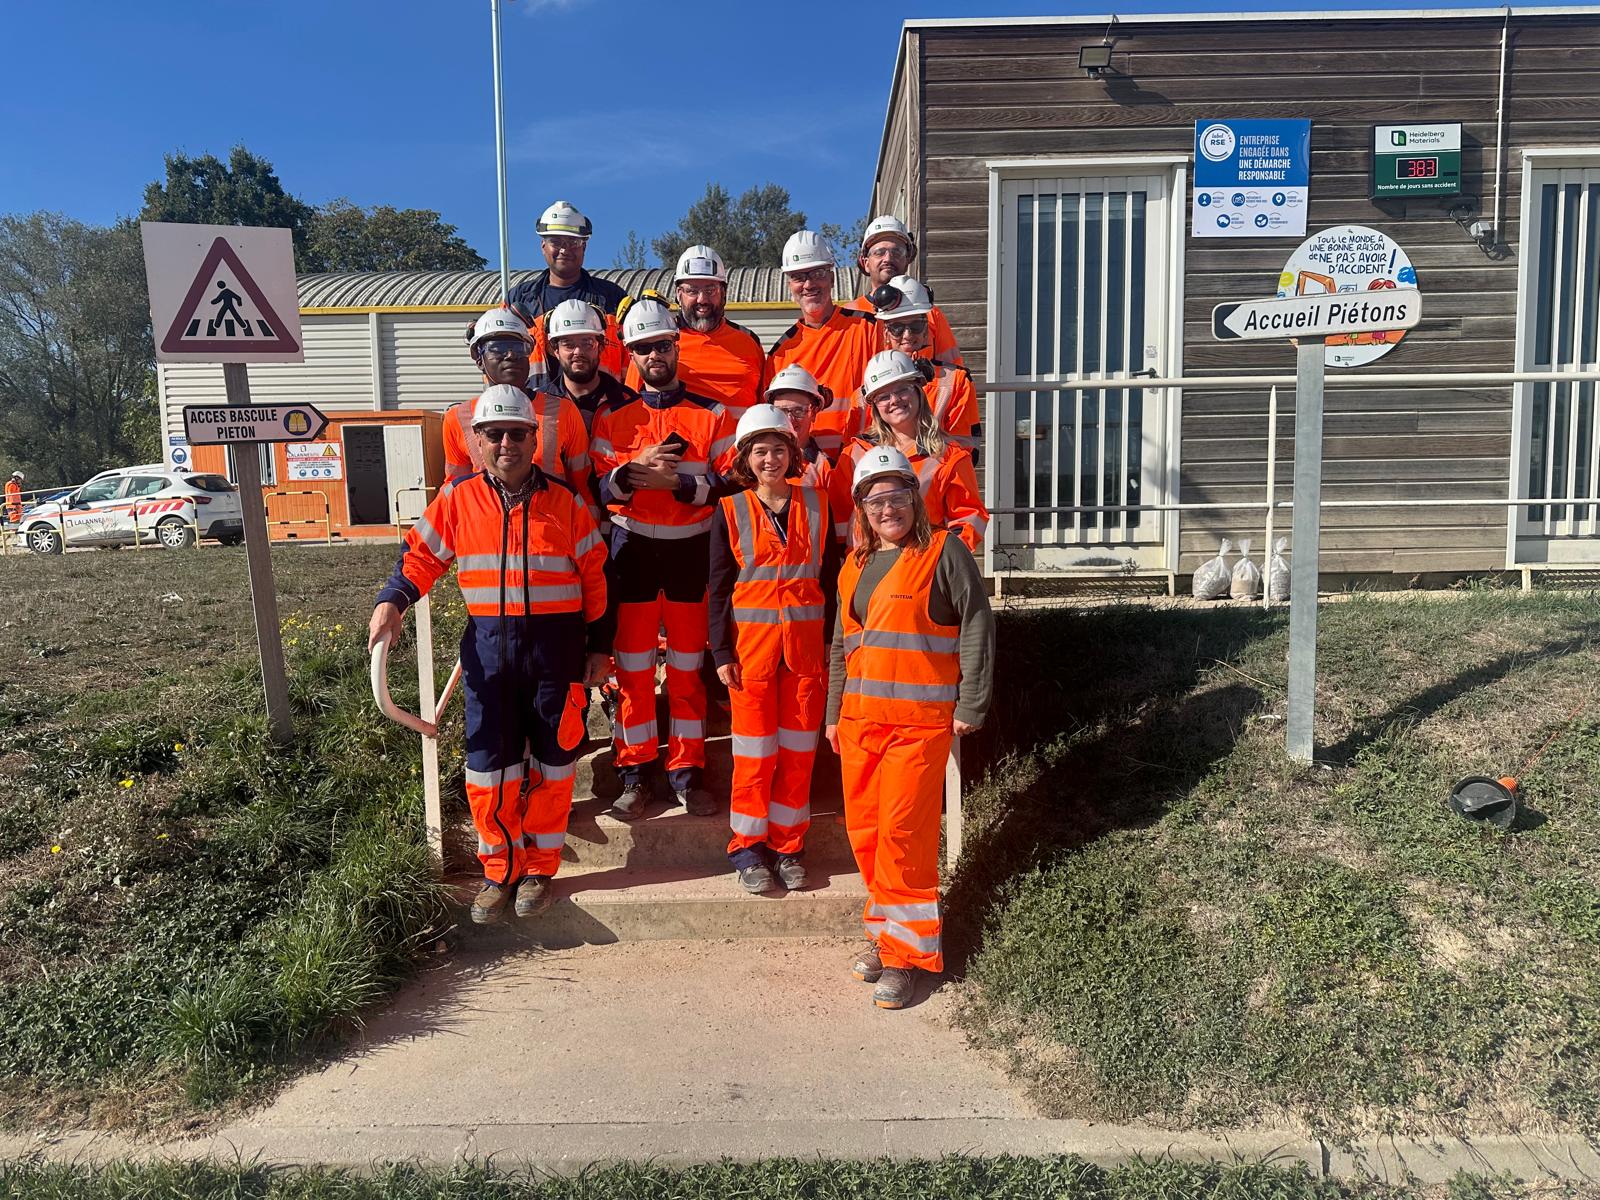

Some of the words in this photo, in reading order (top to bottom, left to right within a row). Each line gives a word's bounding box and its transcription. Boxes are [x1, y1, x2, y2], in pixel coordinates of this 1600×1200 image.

[1240, 135, 1280, 145] ENTREPRISE
[1239, 146, 1270, 158] ENGAGÉE
[1271, 147, 1290, 157] DANS
[1239, 159, 1253, 169] UNE
[1254, 158, 1291, 169] DÉMARCHE
[1408, 160, 1435, 177] 383
[1238, 170, 1286, 181] RESPONSABLE
[1317, 236, 1335, 244] Tout
[1338, 236, 1348, 244] le
[1348, 235, 1374, 243] MONDE
[1309, 243, 1326, 252] UNE
[1327, 243, 1354, 252] BONNE
[1356, 243, 1385, 251] RAISON
[1308, 253, 1318, 261] de
[1319, 253, 1333, 263] NE
[1336, 252, 1355, 263] PAS
[1358, 252, 1387, 262] AVOIR
[1243, 305, 1321, 331] Accueil
[1327, 301, 1407, 325] Piétons
[190, 410, 227, 424] ACCES
[230, 409, 278, 423] BASCULE
[217, 425, 256, 439] PIETON
